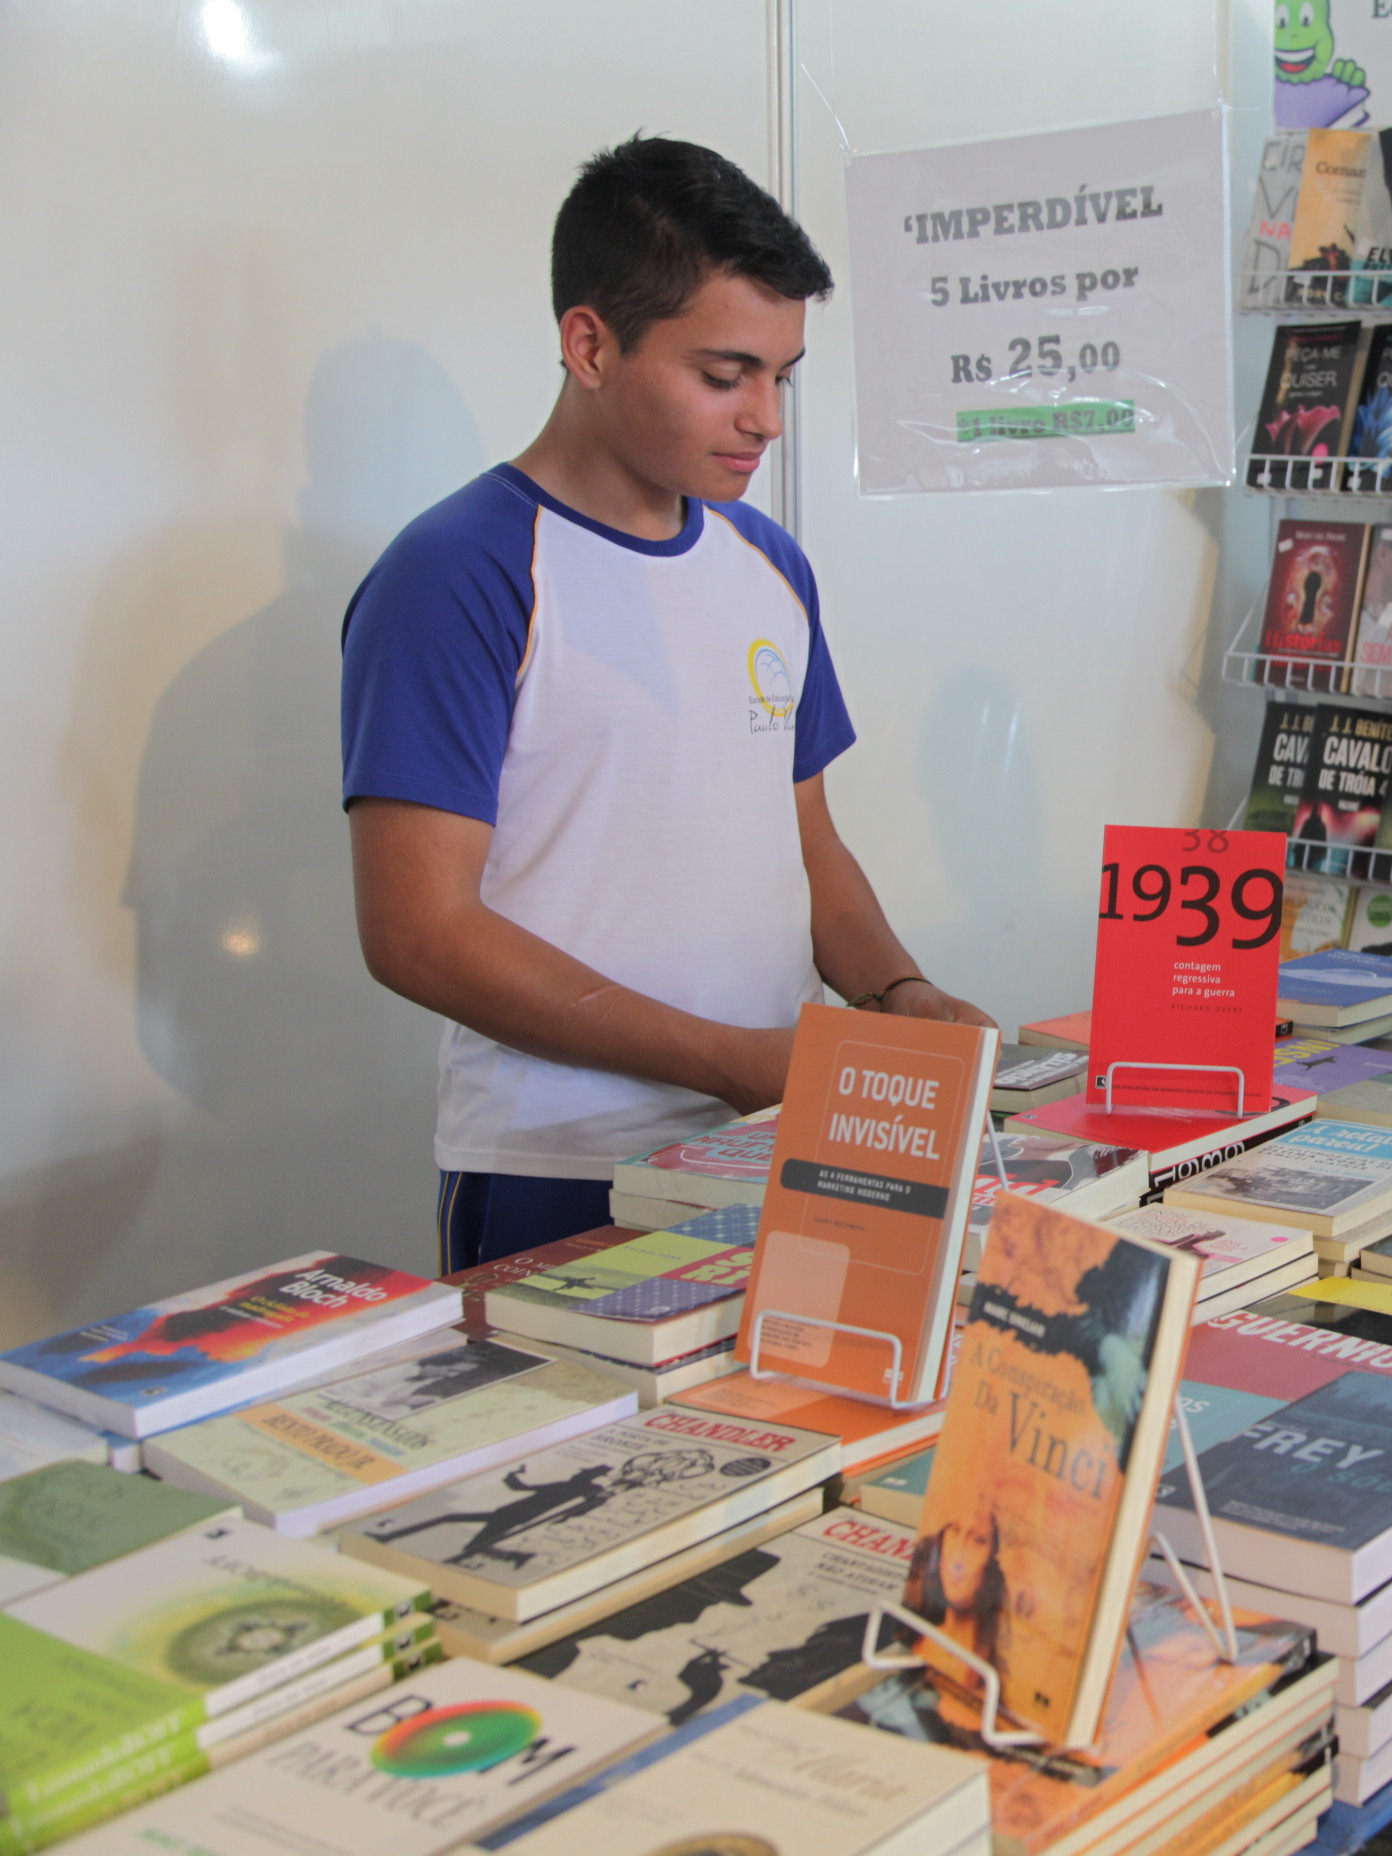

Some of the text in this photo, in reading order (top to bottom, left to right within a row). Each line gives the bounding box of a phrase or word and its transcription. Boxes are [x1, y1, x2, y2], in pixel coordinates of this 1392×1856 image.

[930, 266, 1139, 306] 5 Livros por
[950, 335, 1120, 383] R$ 25,00
[748, 705, 778, 735] Paulo
[1330, 715, 1340, 733] J.
[1342, 717, 1351, 734] J.
[1268, 765, 1283, 786] DE
[1318, 768, 1336, 791] DE
[1339, 769, 1375, 796] TRÓIA
[1099, 862, 1283, 949] 1939
[1173, 973, 1220, 986] regressiva
[1174, 961, 1221, 973] contagem
[1172, 986, 1235, 998] para a guerra
[1171, 1004, 1211, 1012] RICHARD
[838, 1066, 939, 1110] O TOQUE
[828, 1112, 940, 1160] INVISÍVEL
[1302, 1125, 1329, 1134] A
[817, 1180, 891, 1202] MARKETING MODERNO
[819, 1169, 827, 1178] AS
[836, 1172, 883, 1190] FERRAMENTAS
[885, 1180, 902, 1192] PARA
[905, 1185, 911, 1194] O
[279, 1280, 349, 1309] Bloch
[294, 1268, 388, 1302] Arnaldo
[972, 1343, 1086, 1414] A Conspiração
[643, 1413, 797, 1453] CHANDLER
[974, 1380, 998, 1416] Da
[1008, 1391, 1106, 1500] Vinci
[1243, 1424, 1386, 1469] FREY
